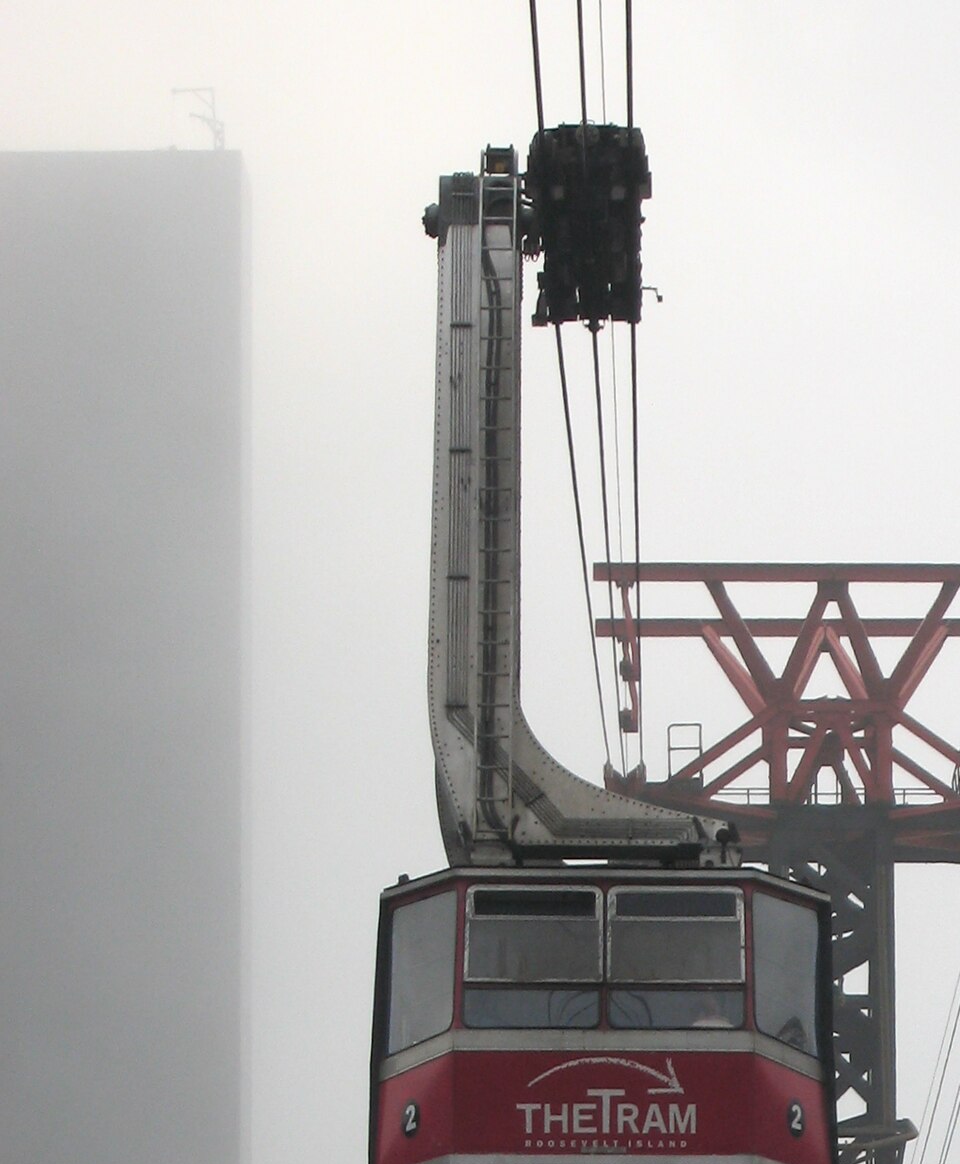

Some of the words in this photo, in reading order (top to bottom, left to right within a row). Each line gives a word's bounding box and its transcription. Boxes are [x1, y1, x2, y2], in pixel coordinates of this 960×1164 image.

[405, 1104, 418, 1130] 2
[790, 1104, 803, 1130] 2
[524, 1139, 619, 1149] ROOSEVELT
[628, 1139, 688, 1149] ISLAND
